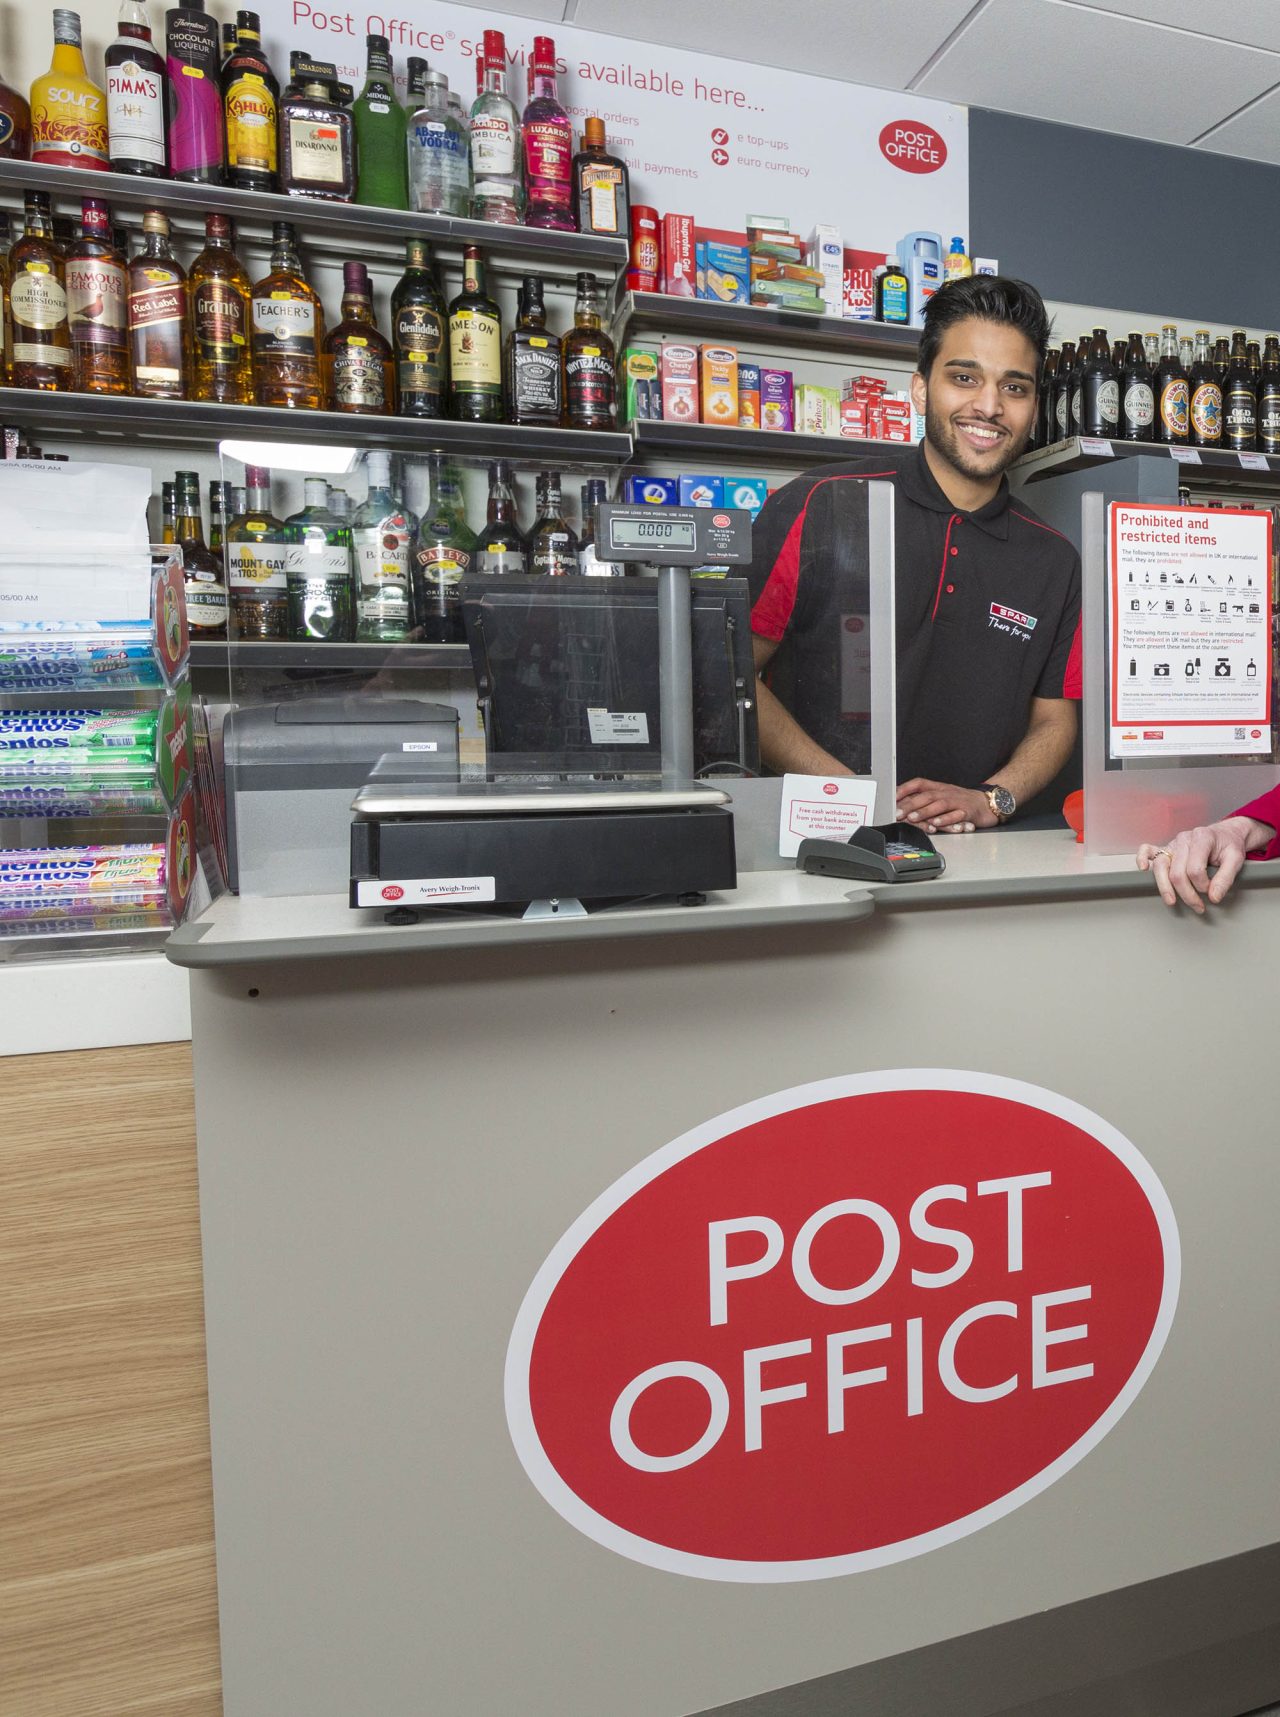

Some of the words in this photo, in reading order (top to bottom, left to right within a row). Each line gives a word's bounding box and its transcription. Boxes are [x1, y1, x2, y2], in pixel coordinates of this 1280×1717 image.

[169, 33, 216, 48] CHOCOLATE
[174, 41, 210, 53] LIQUEUR
[293, 1, 355, 35] Post
[578, 58, 684, 97] available
[109, 77, 157, 99] PIMM'S
[366, 92, 391, 102] MIDORI
[566, 104, 599, 121] postal
[603, 111, 640, 126] orders
[471, 130, 512, 143] AMBUCA
[530, 125, 569, 140] LUXARDO
[895, 129, 934, 147] POST
[295, 140, 338, 153] DISARONNO
[420, 137, 458, 151] VODKA
[747, 134, 789, 151] top-ups
[885, 143, 940, 164] OFFICE
[624, 156, 641, 170] bill
[644, 161, 698, 179] payments
[737, 156, 762, 168] euro
[765, 158, 810, 178] currency
[682, 258, 692, 272] Gel
[71, 271, 122, 287] FAMOUS
[843, 268, 872, 290] PRO
[26, 289, 49, 298] HIGH
[72, 280, 122, 296] GROUSE
[132, 301, 151, 314] Red
[152, 297, 179, 310] Label
[198, 298, 240, 318] Grant's
[256, 301, 311, 320] TEACHER'S
[400, 321, 440, 336] Glenfiddich
[363, 361, 384, 373] REGAL
[414, 363, 424, 373] 12
[515, 353, 533, 367] JACK
[533, 352, 559, 371] DANIEL'S
[668, 362, 692, 370] Chesty
[885, 407, 906, 416] Rennie
[1232, 408, 1250, 417] OLD
[1121, 513, 1183, 529] Prohibited
[1188, 518, 1209, 529] and
[638, 522, 672, 538] 0.000
[1121, 531, 1180, 544] restricted
[1185, 533, 1217, 545] items
[366, 550, 407, 561] BACARD
[420, 548, 470, 569] BAILEYS
[1133, 549, 1155, 557] following
[230, 558, 263, 569] MOUNT
[266, 560, 286, 570] GAY
[238, 568, 258, 578] 1703
[1000, 608, 1027, 624] SPAR
[989, 616, 1010, 632] There
[1010, 625, 1022, 636] for
[0, 736, 70, 749] entos
[825, 809, 858, 817] withdrawals
[419, 886, 437, 894] Avery
[438, 884, 480, 893] Weigh-Tronix
[708, 1171, 1052, 1327] POST
[609, 1284, 1095, 1474] OFFICE
